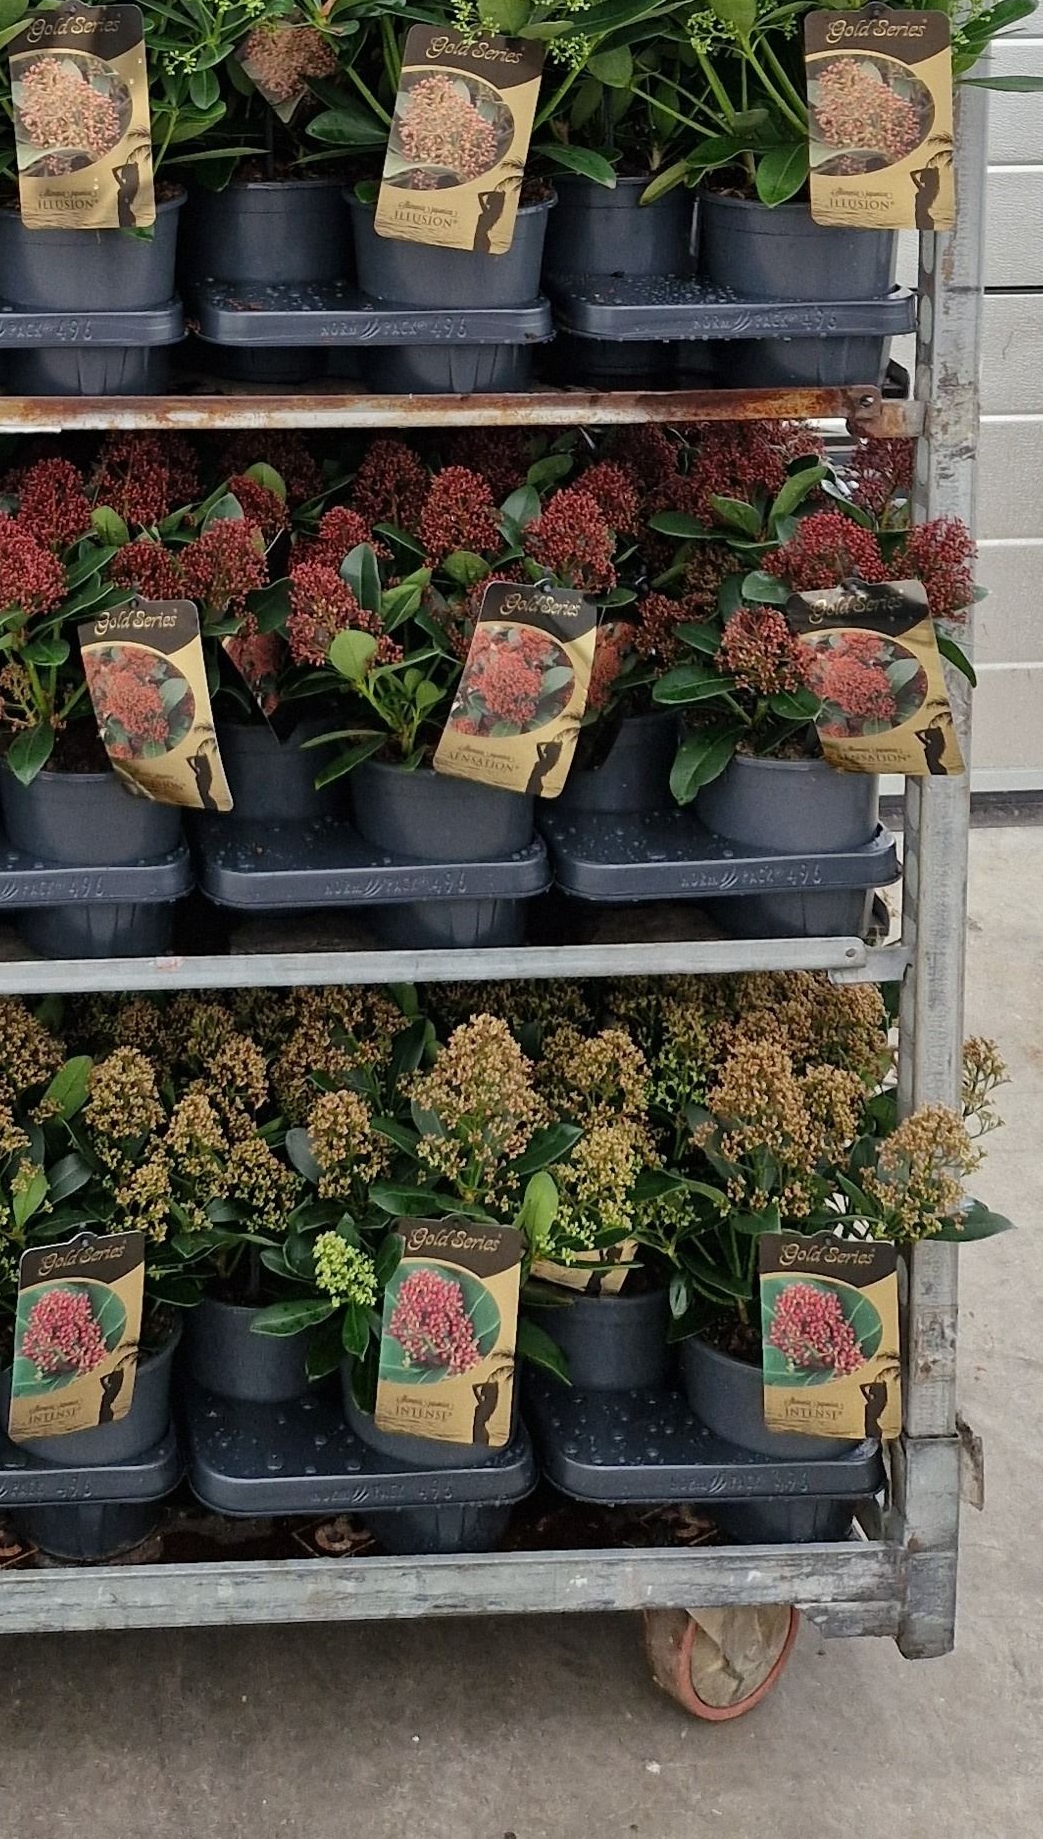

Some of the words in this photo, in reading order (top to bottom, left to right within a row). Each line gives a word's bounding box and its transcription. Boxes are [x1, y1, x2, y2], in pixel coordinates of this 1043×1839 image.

[27, 15, 71, 43] Gold
[69, 15, 121, 34] Series
[826, 19, 872, 44] Gold
[873, 19, 926, 38] Series
[426, 36, 472, 59] Gold
[470, 42, 523, 64] Series
[37, 198, 94, 211] ILLUSION
[829, 198, 890, 210] ILLUSION
[394, 210, 452, 227] ILLUSION
[500, 593, 544, 615] Gold
[540, 596, 581, 617] Series
[94, 611, 135, 636] Gold
[132, 610, 177, 629] Series
[449, 751, 515, 772] SENSATION
[407, 1227, 452, 1251] Gold
[450, 1231, 499, 1252] Series
[38, 1250, 82, 1276] Gold
[79, 1245, 125, 1264] Series
[779, 1243, 824, 1265] Gold
[823, 1247, 875, 1265] Series
[29, 1408, 77, 1424] INTENSE
[397, 1403, 447, 1421] INTENSE
[786, 1407, 837, 1420] INTENSE
